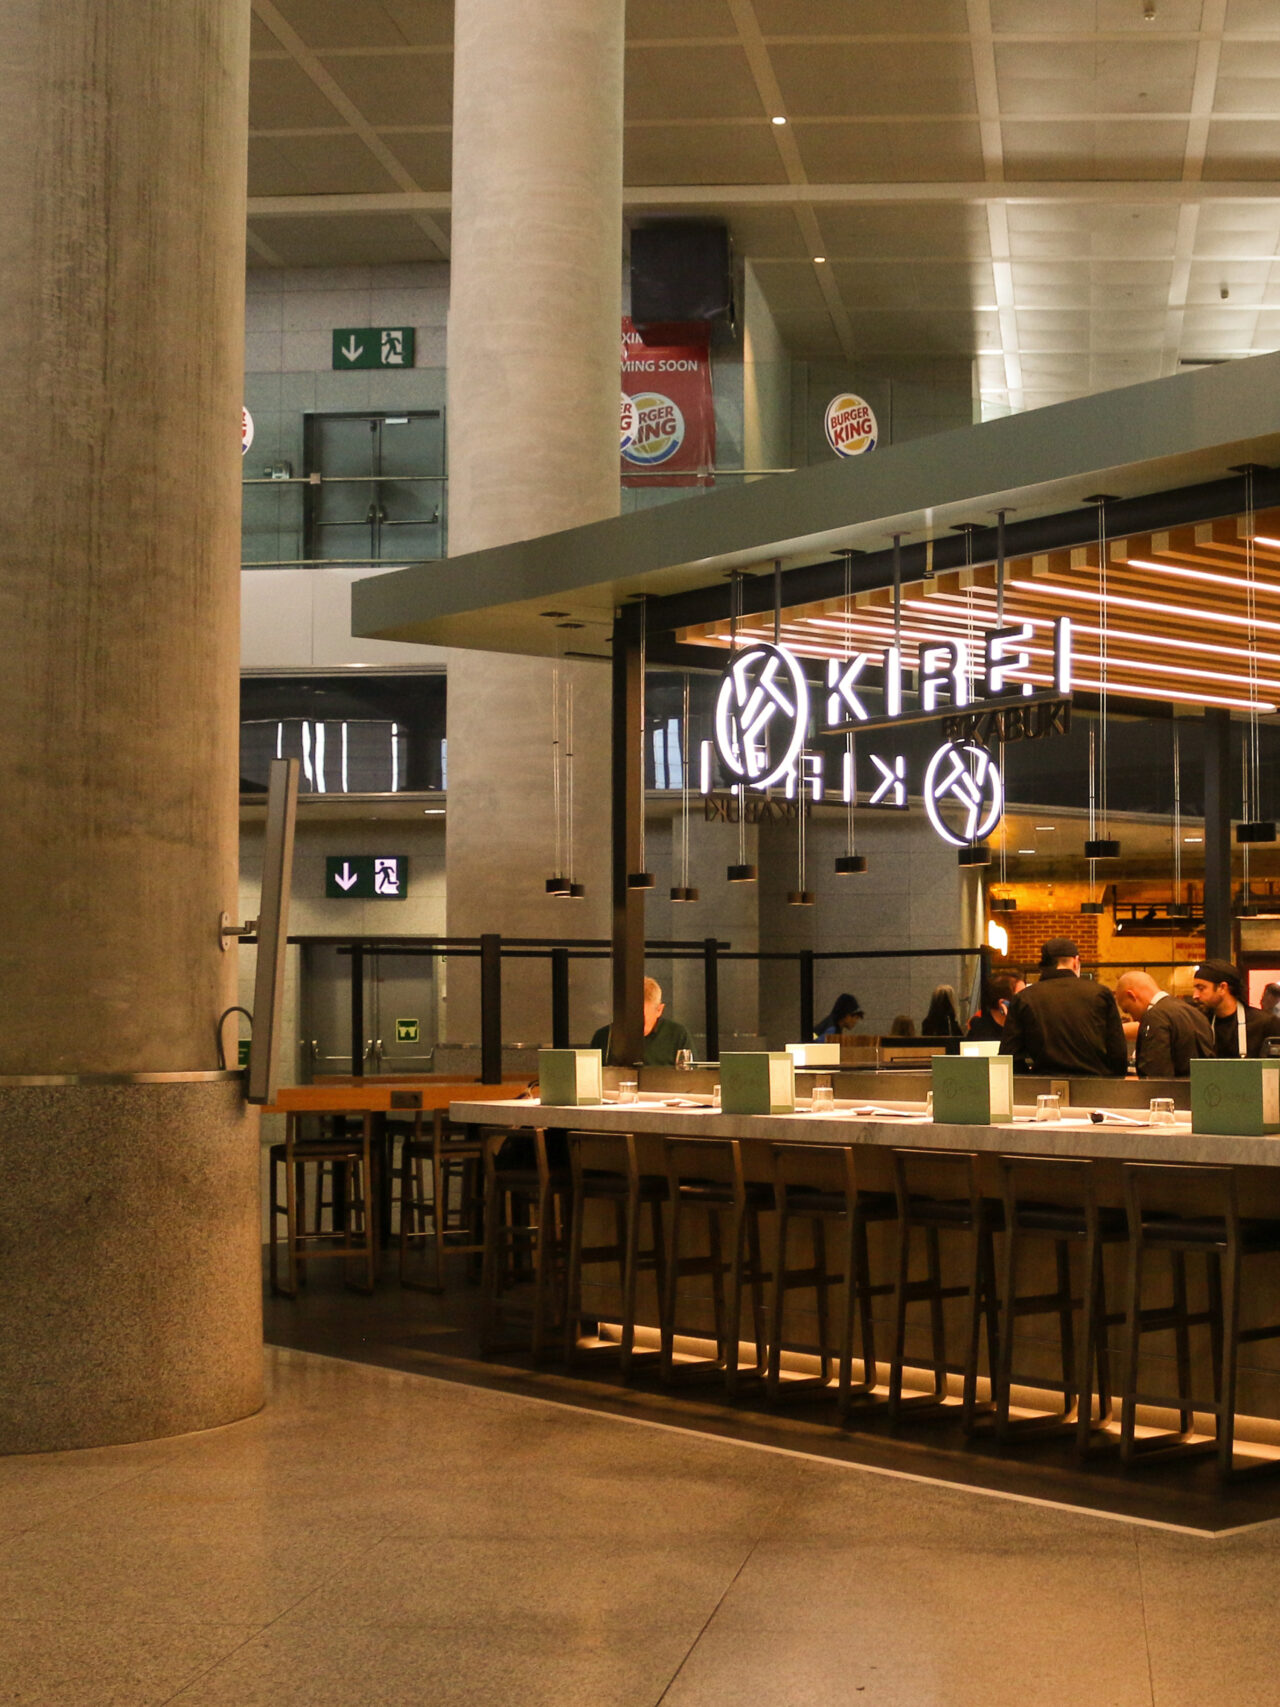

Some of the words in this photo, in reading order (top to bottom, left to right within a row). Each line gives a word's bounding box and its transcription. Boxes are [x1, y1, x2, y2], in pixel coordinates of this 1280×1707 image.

[620, 360, 655, 372] MING
[658, 360, 699, 372] SOON
[638, 405, 674, 425] RGER
[831, 406, 869, 429] BURGER
[834, 418, 872, 446] KING
[823, 616, 1071, 726] KIREI
[965, 700, 1072, 745] KABUKI
